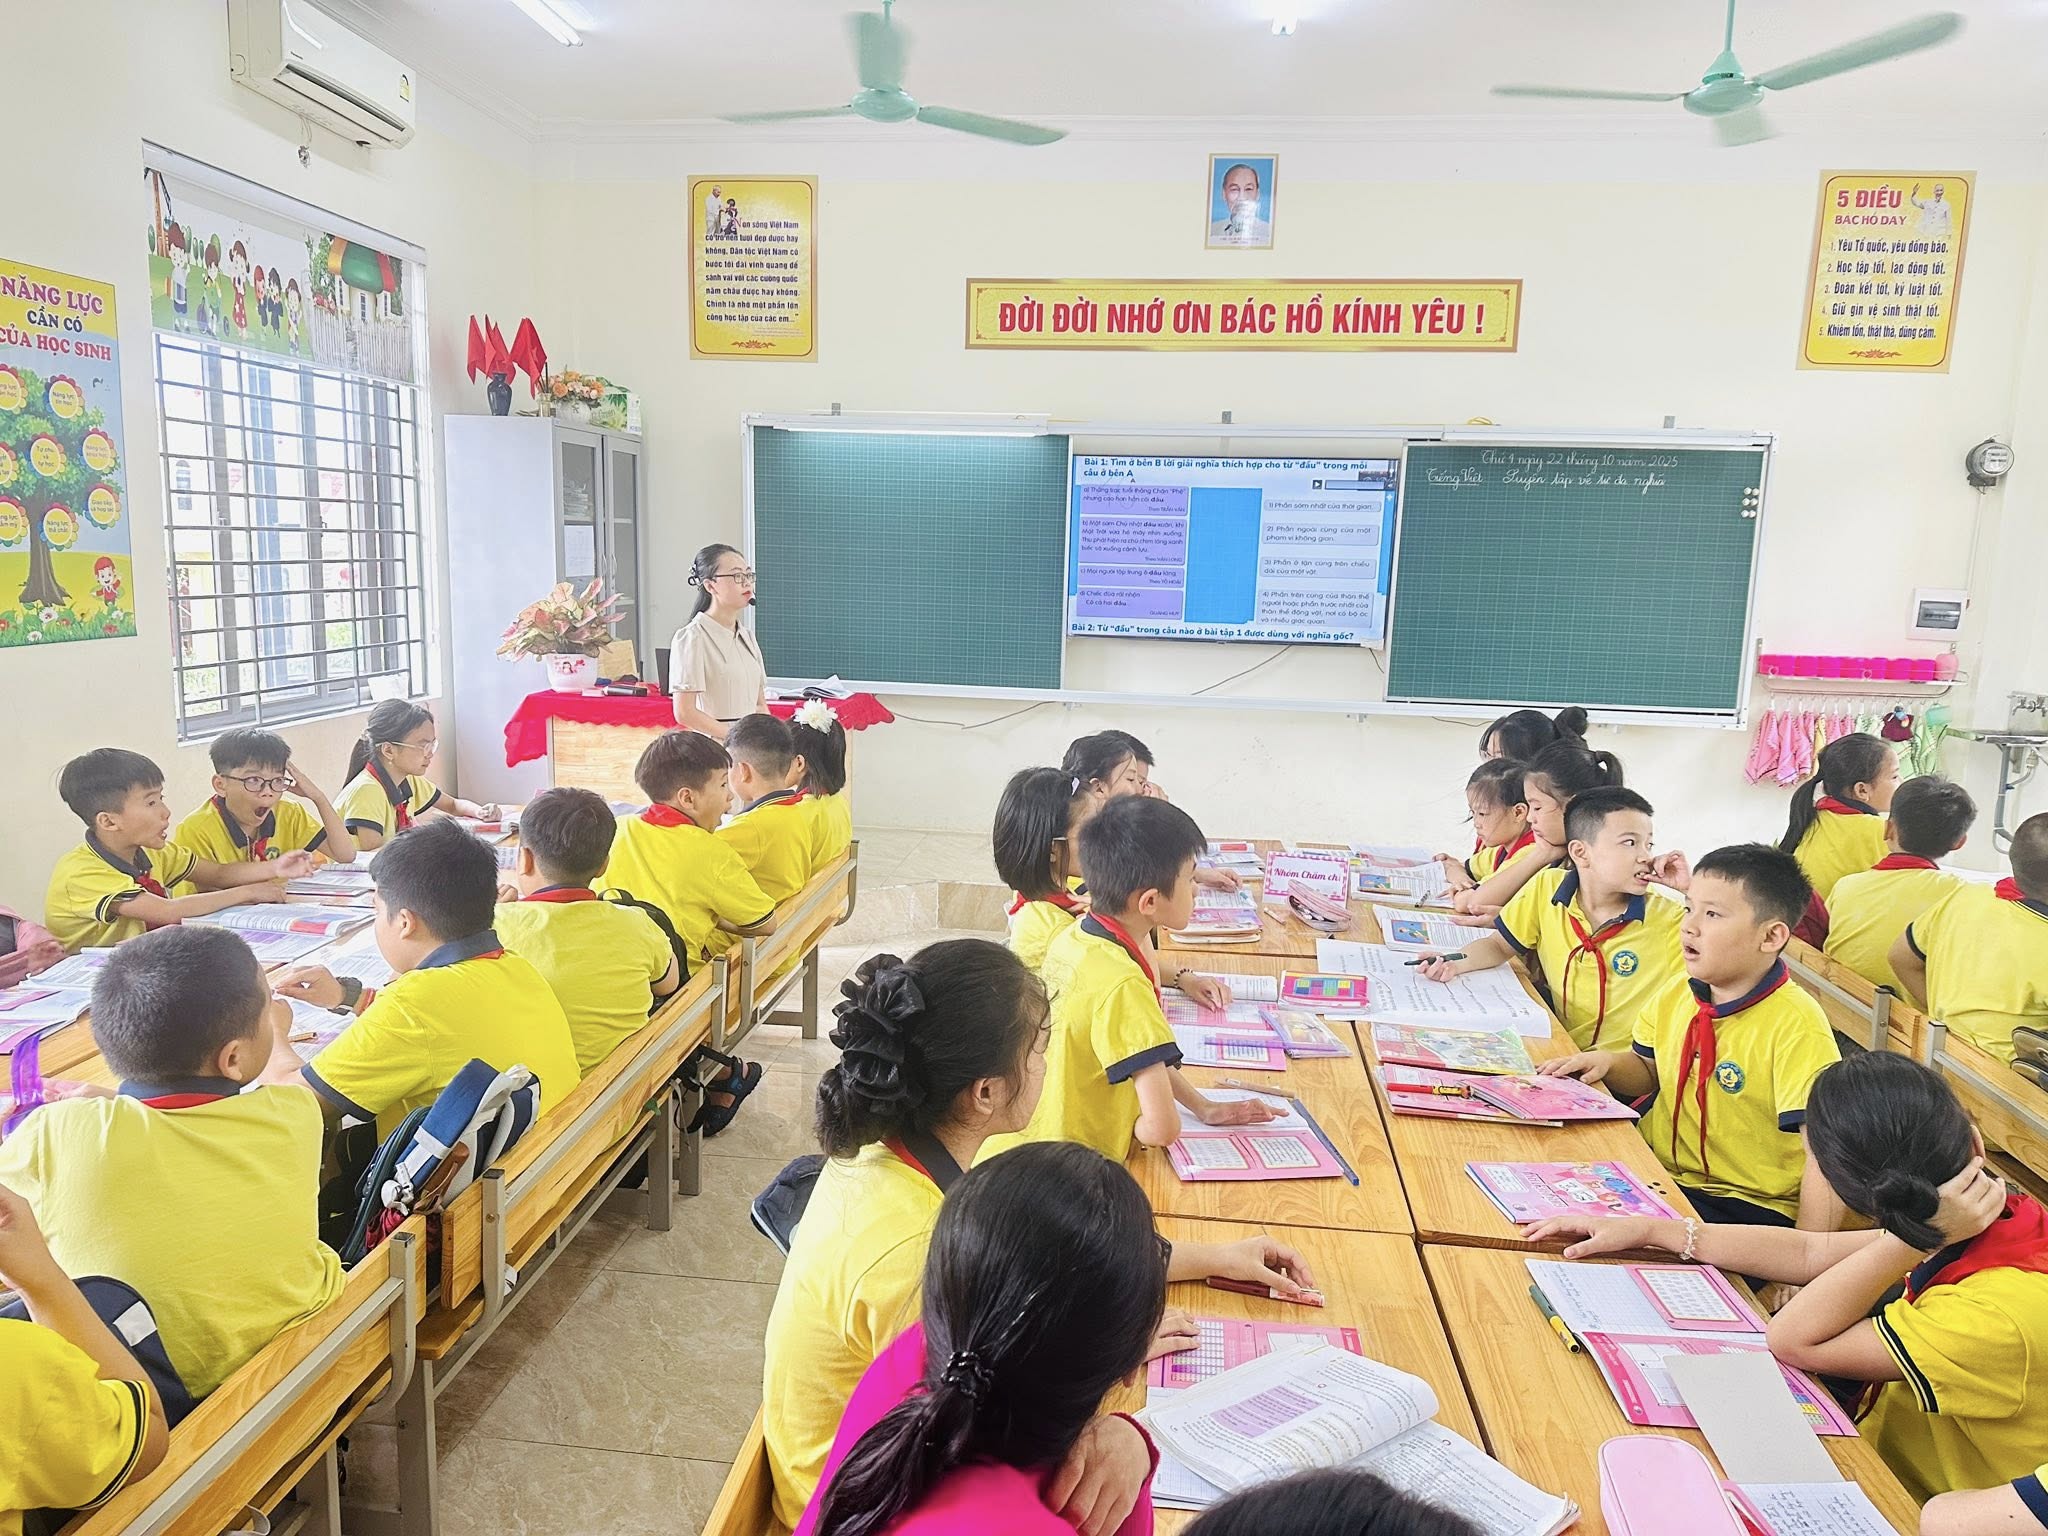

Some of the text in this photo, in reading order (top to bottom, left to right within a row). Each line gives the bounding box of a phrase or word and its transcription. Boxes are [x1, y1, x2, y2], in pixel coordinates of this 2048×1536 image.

[1838, 184, 1902, 208] 5 ĐIỀU
[757, 248, 771, 256] Việt
[1839, 238, 1852, 251] Yêu
[1891, 240, 1906, 253] yêu
[1837, 260, 1852, 275] Học
[1856, 260, 1869, 276] tập
[1891, 262, 1903, 274] lao
[1908, 262, 1928, 276] động
[1932, 260, 1945, 274] tốt.
[1, 274, 103, 316] NĂNG LỰC
[762, 288, 774, 296] hay
[1859, 282, 1872, 295] kết
[1877, 282, 1889, 295] tốt,
[1909, 283, 1925, 298] luật
[1929, 282, 1942, 296] tốt.
[27, 305, 82, 332] CẦN CÓ
[725, 314, 736, 322] học
[999, 293, 1485, 334] ĐỜI ĐỜI NHỚ ƠN BÁC HỒ KÍNH YÊU !
[1869, 304, 1877, 319] vệ
[1883, 304, 1900, 316] sinh
[1905, 304, 1922, 319] thật
[1926, 303, 1940, 317] tốt.
[1827, 324, 1850, 337] Khiêm
[1868, 325, 1881, 340] thật
[36, 334, 70, 356] HỌC
[75, 341, 111, 360] SINH
[1084, 458, 1098, 466] Bài
[1100, 458, 1108, 466] 1:
[1111, 458, 1127, 466] Tìm
[1137, 459, 1152, 467] bên
[1155, 459, 1161, 467] B
[1164, 459, 1175, 467] lời
[1177, 460, 1192, 469] giải
[1196, 460, 1219, 469] nghĩa
[1222, 460, 1243, 468] thích
[1246, 461, 1262, 470] hợp
[1265, 461, 1281, 469] cho
[1283, 461, 1293, 469] từ
[1323, 462, 1348, 471] trong
[1518, 454, 1542, 472] ngày
[1547, 453, 1563, 464] 22
[1566, 451, 1598, 474] tháng
[1601, 454, 1615, 465] 10
[1648, 455, 1679, 468] 2025
[1109, 469, 1124, 477] bên
[1098, 624, 1108, 632] Từ
[1136, 627, 1160, 635] trong
[1163, 626, 1177, 634] câu
[1220, 629, 1234, 638] tập
[1244, 630, 1264, 638] được
[1267, 630, 1289, 639] dùng
[1291, 630, 1304, 638] với
[1307, 630, 1331, 640] nghĩa
[1334, 631, 1353, 640] gốc?
[1274, 868, 1299, 878] Nhóm
